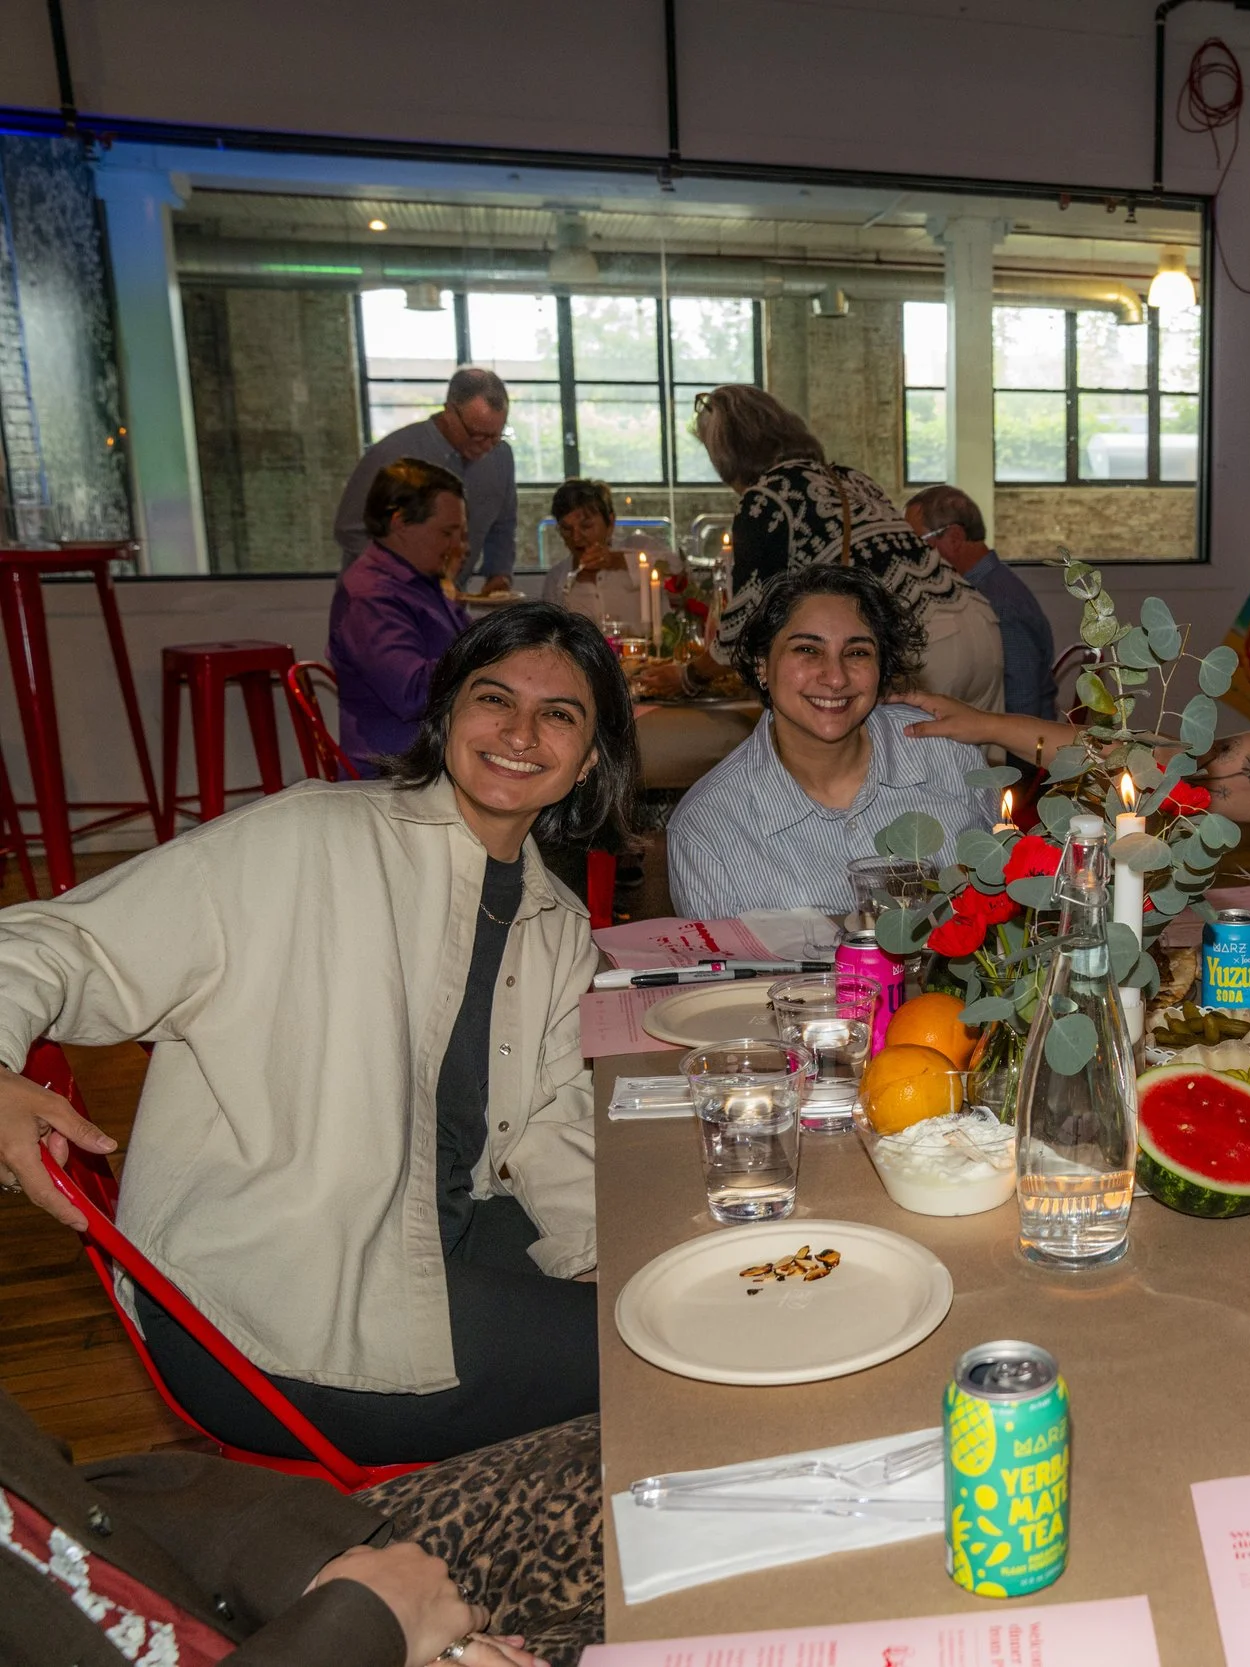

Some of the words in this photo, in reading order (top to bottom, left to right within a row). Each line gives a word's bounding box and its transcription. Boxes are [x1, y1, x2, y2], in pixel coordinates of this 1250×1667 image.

[1213, 943, 1247, 954] MARZ
[1216, 988, 1244, 1003] SODA
[1018, 1511, 1065, 1552] TEA
